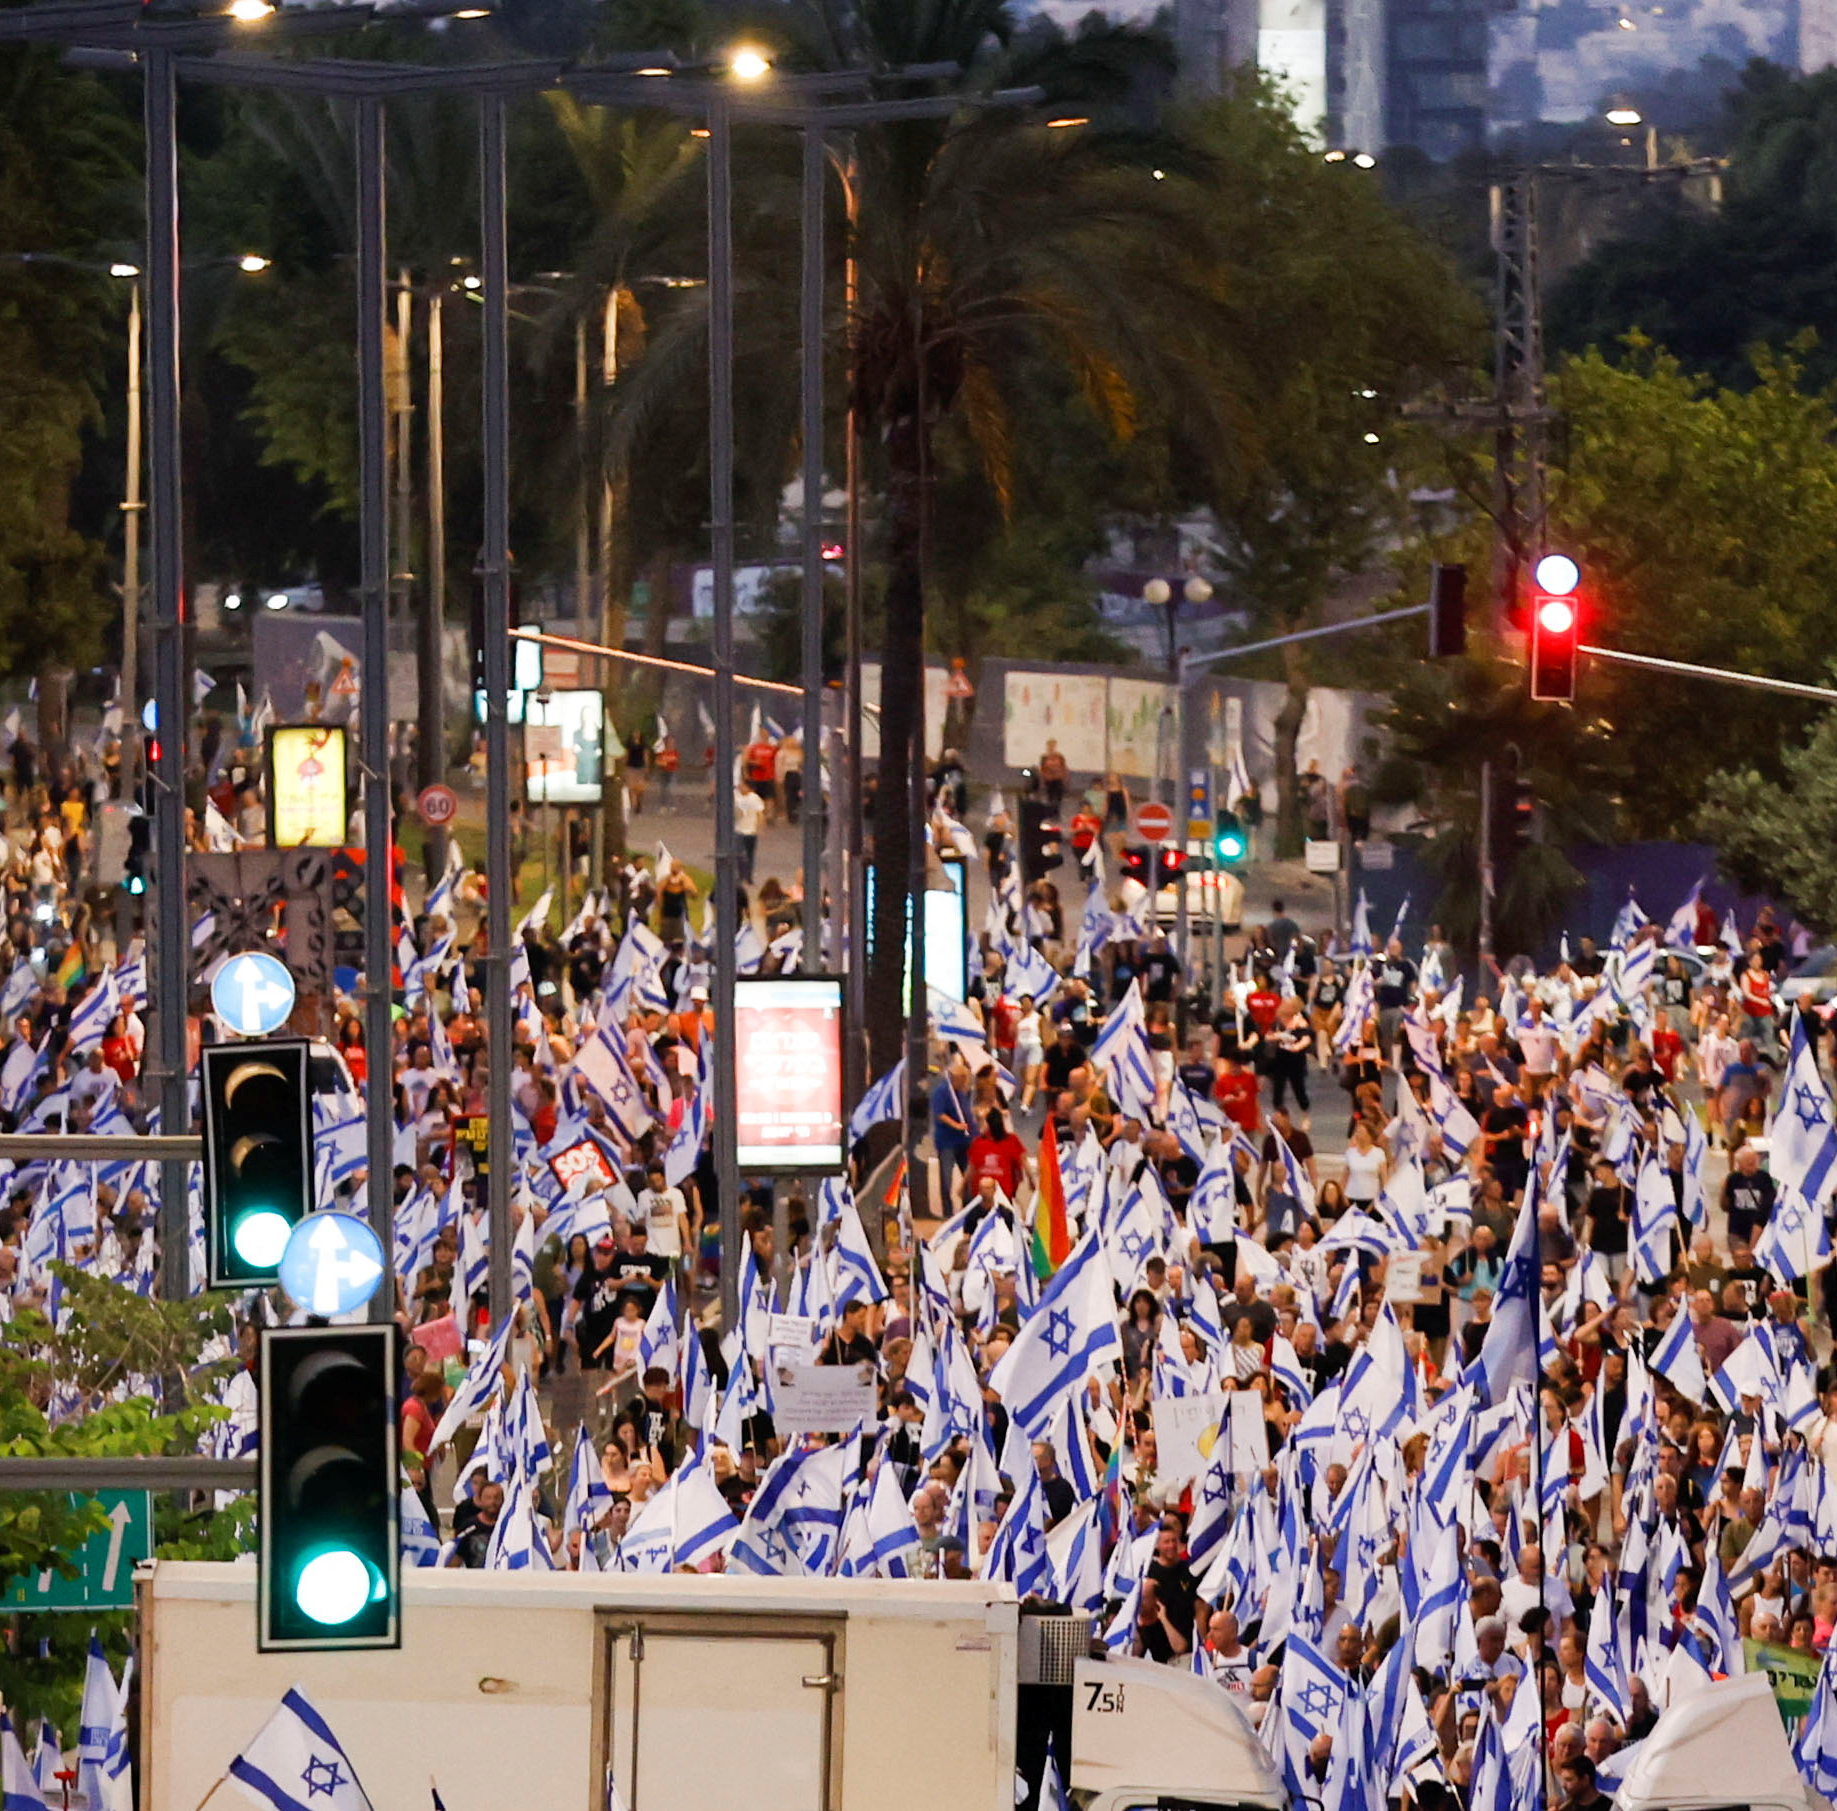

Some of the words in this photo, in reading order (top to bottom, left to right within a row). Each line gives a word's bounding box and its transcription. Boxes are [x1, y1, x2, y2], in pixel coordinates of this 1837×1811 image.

[426, 796, 449, 811] 60
[1083, 1682, 1114, 1713] 7.5
[1116, 1684, 1125, 1713] TON
